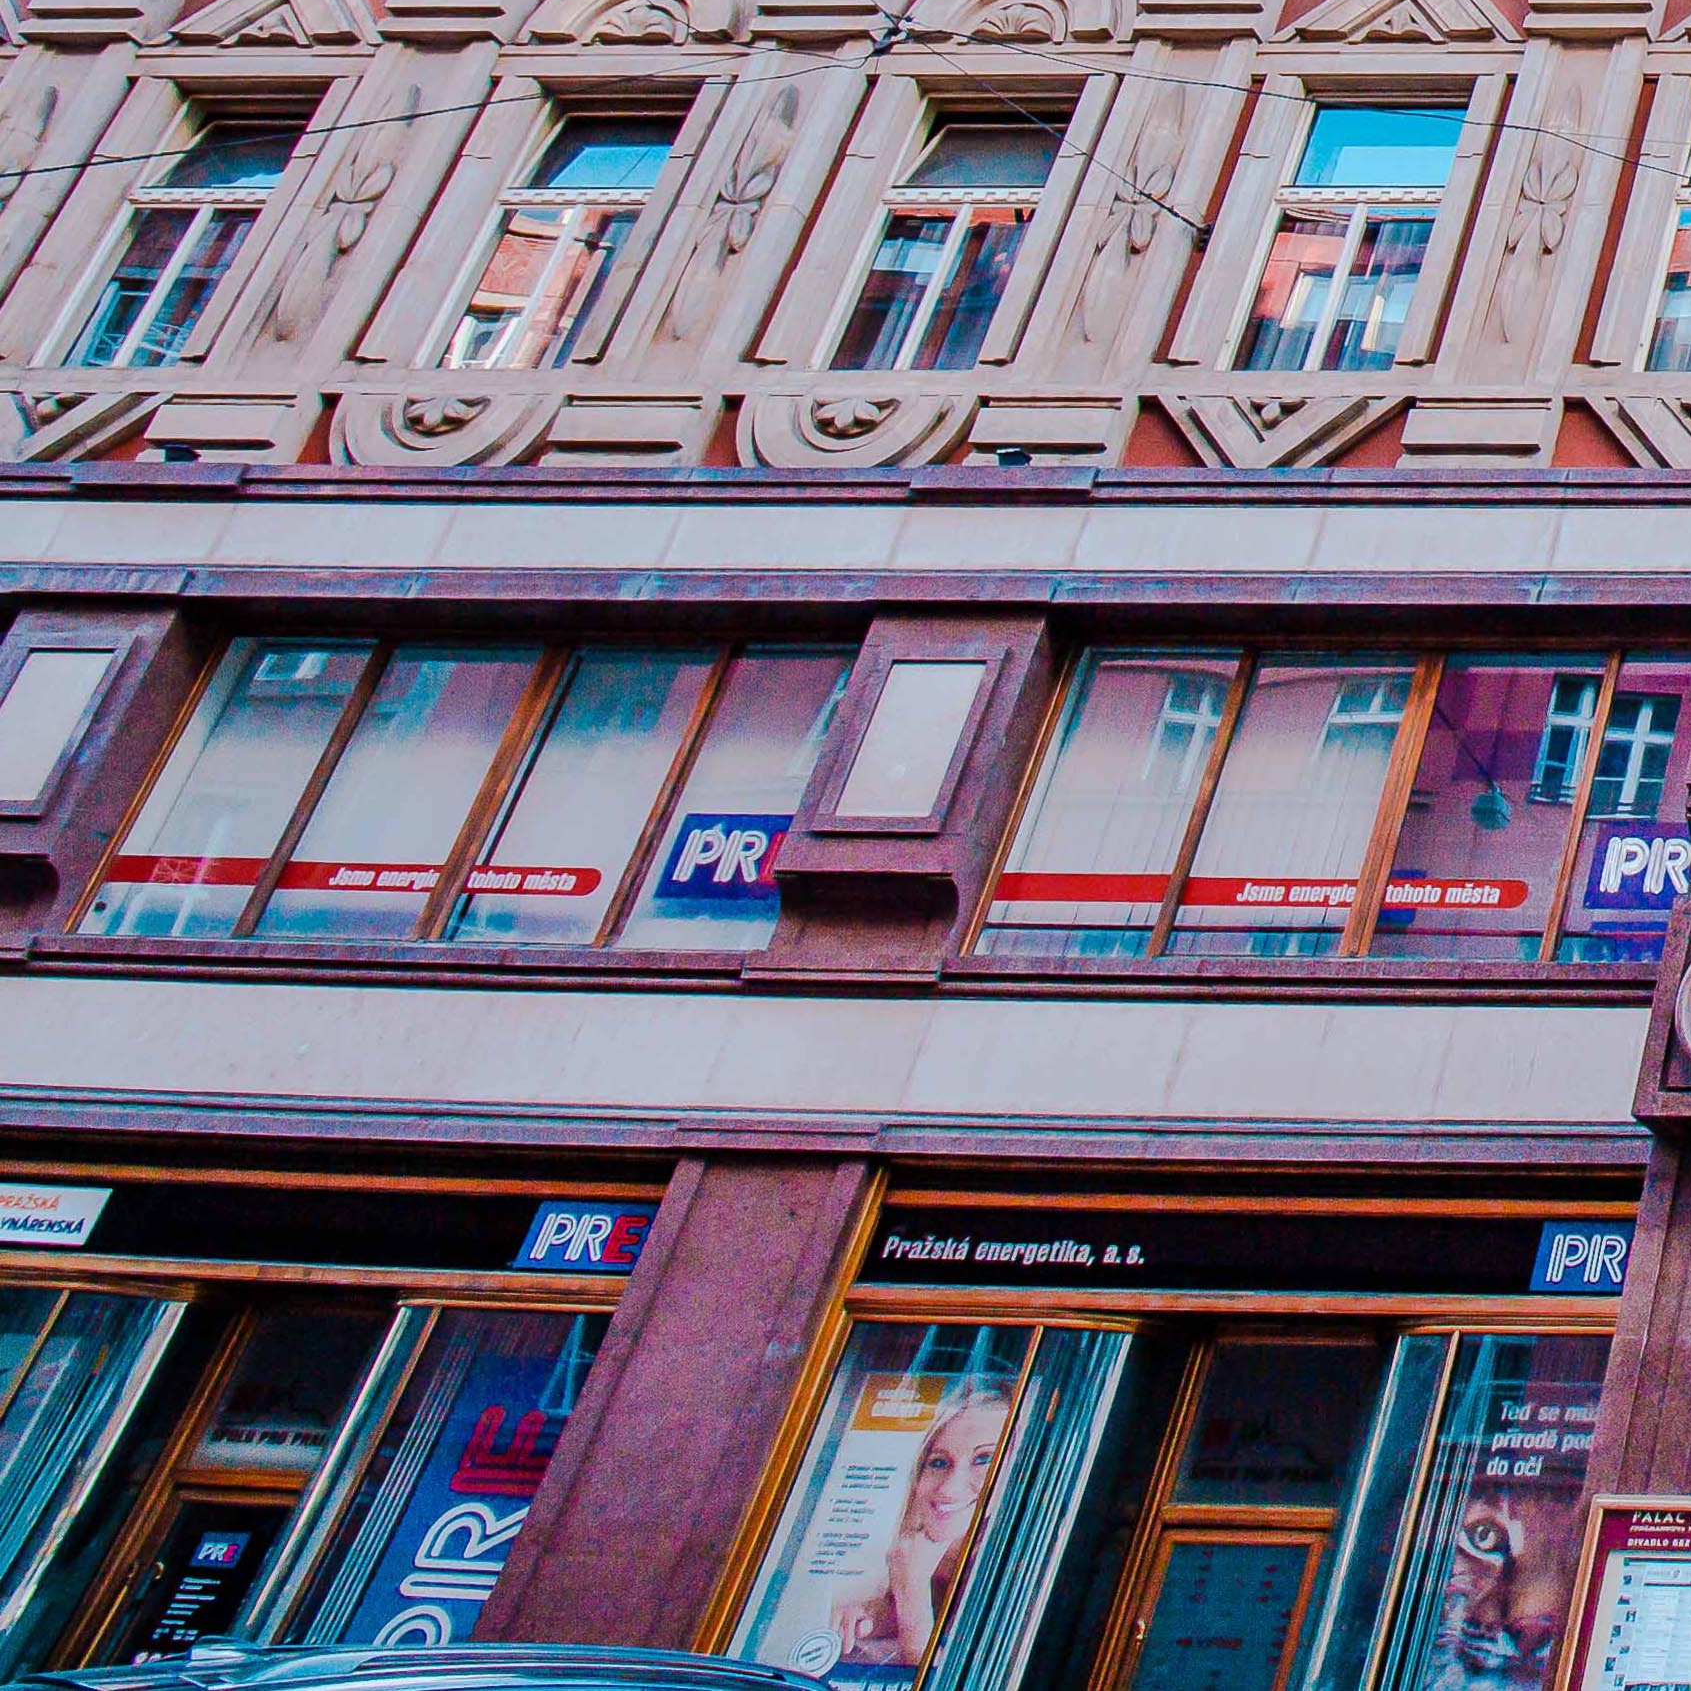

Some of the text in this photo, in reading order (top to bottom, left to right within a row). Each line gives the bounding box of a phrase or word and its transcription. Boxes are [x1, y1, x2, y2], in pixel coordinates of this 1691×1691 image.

[1236, 882, 1285, 902] Jsme
[1385, 884, 1441, 904] tohoto
[1444, 883, 1501, 904] města
[529, 1213, 648, 1263] PRE
[882, 1235, 971, 1260] Pražská
[974, 1238, 1095, 1267] energetika,
[198, 1542, 239, 1563] PRE
